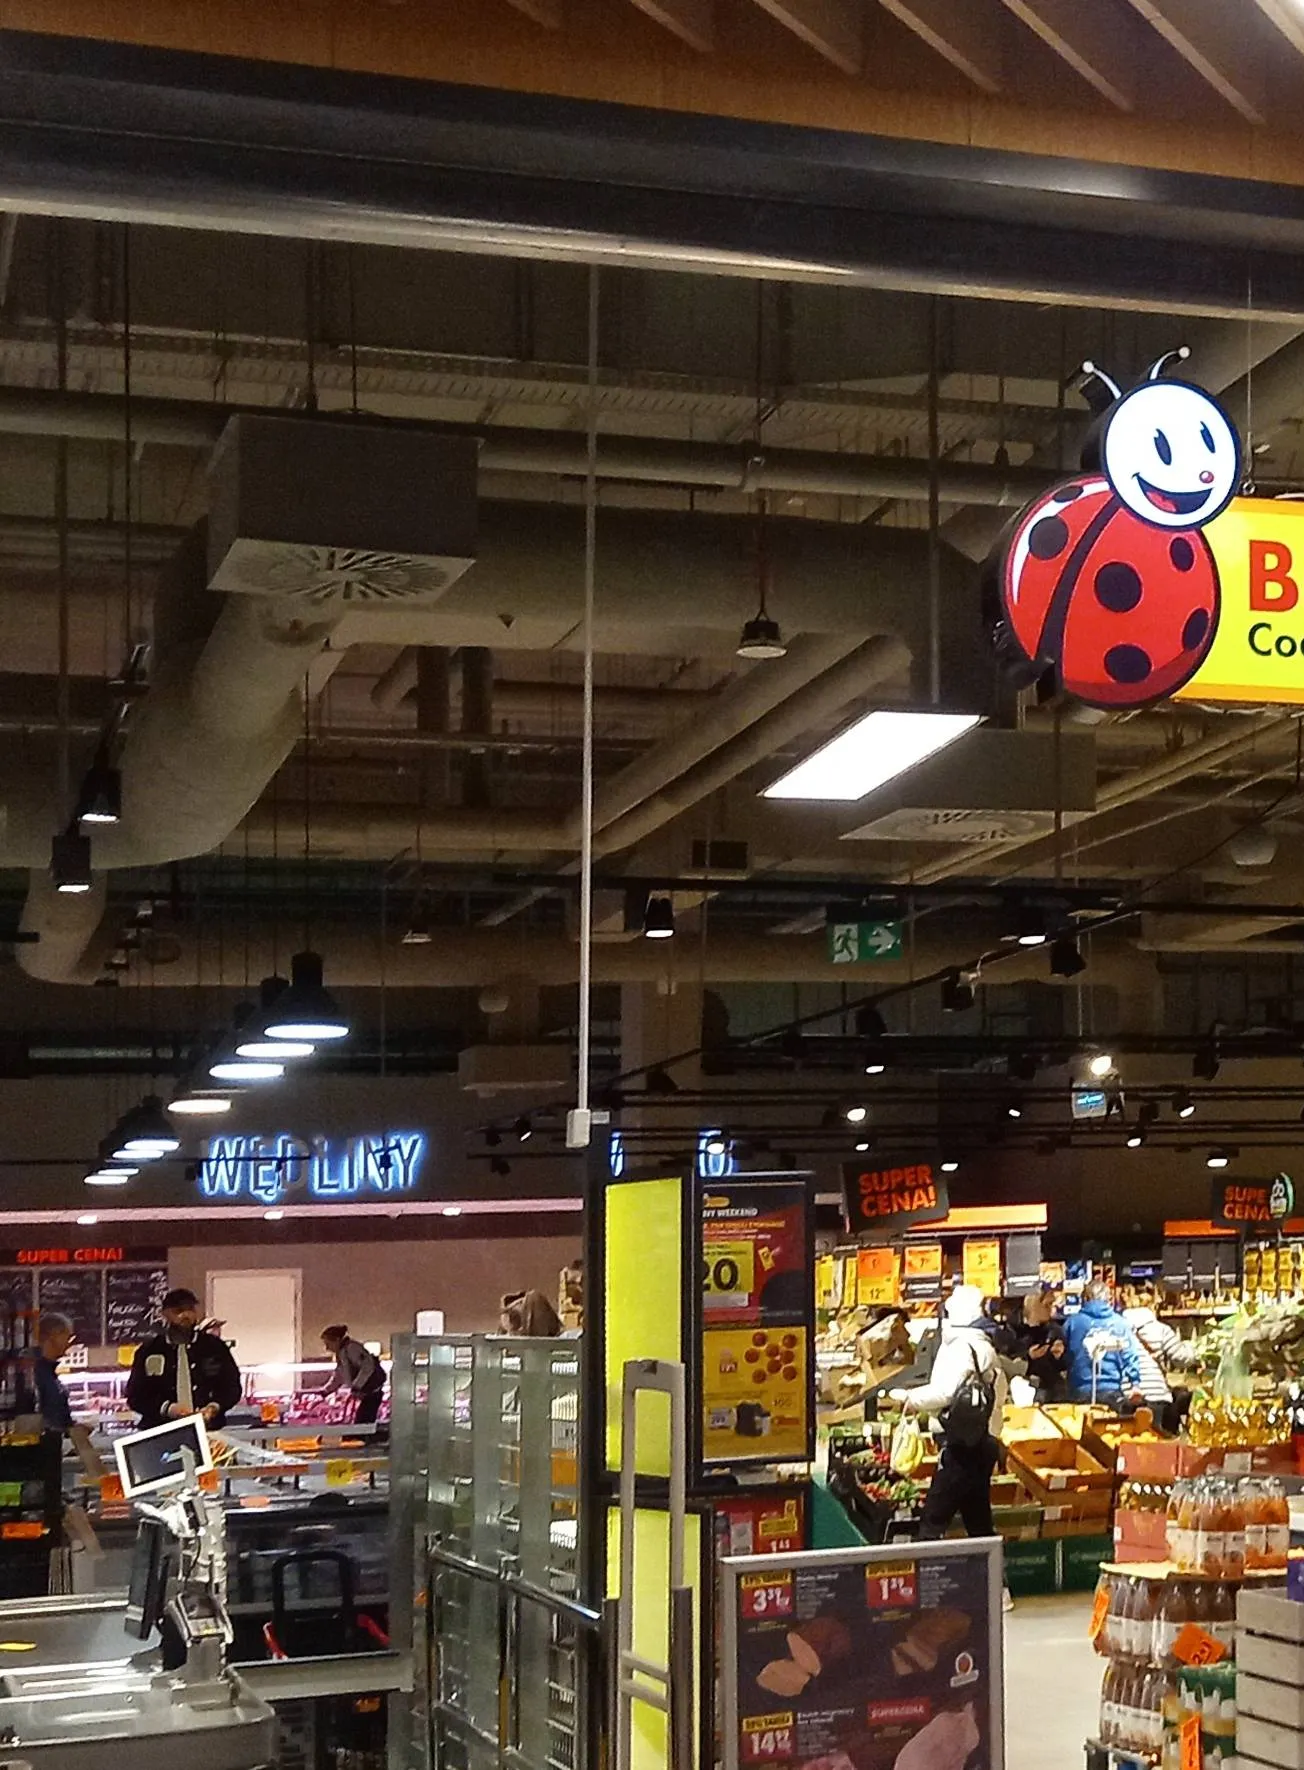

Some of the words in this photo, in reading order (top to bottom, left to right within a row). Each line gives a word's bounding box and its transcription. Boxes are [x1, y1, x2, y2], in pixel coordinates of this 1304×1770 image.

[858, 1164, 933, 1193] SUPER
[861, 1185, 938, 1217] CENA!
[1225, 1185, 1267, 1202] SUPE
[16, 1248, 69, 1264] SUPER
[74, 1247, 125, 1262] CENA!
